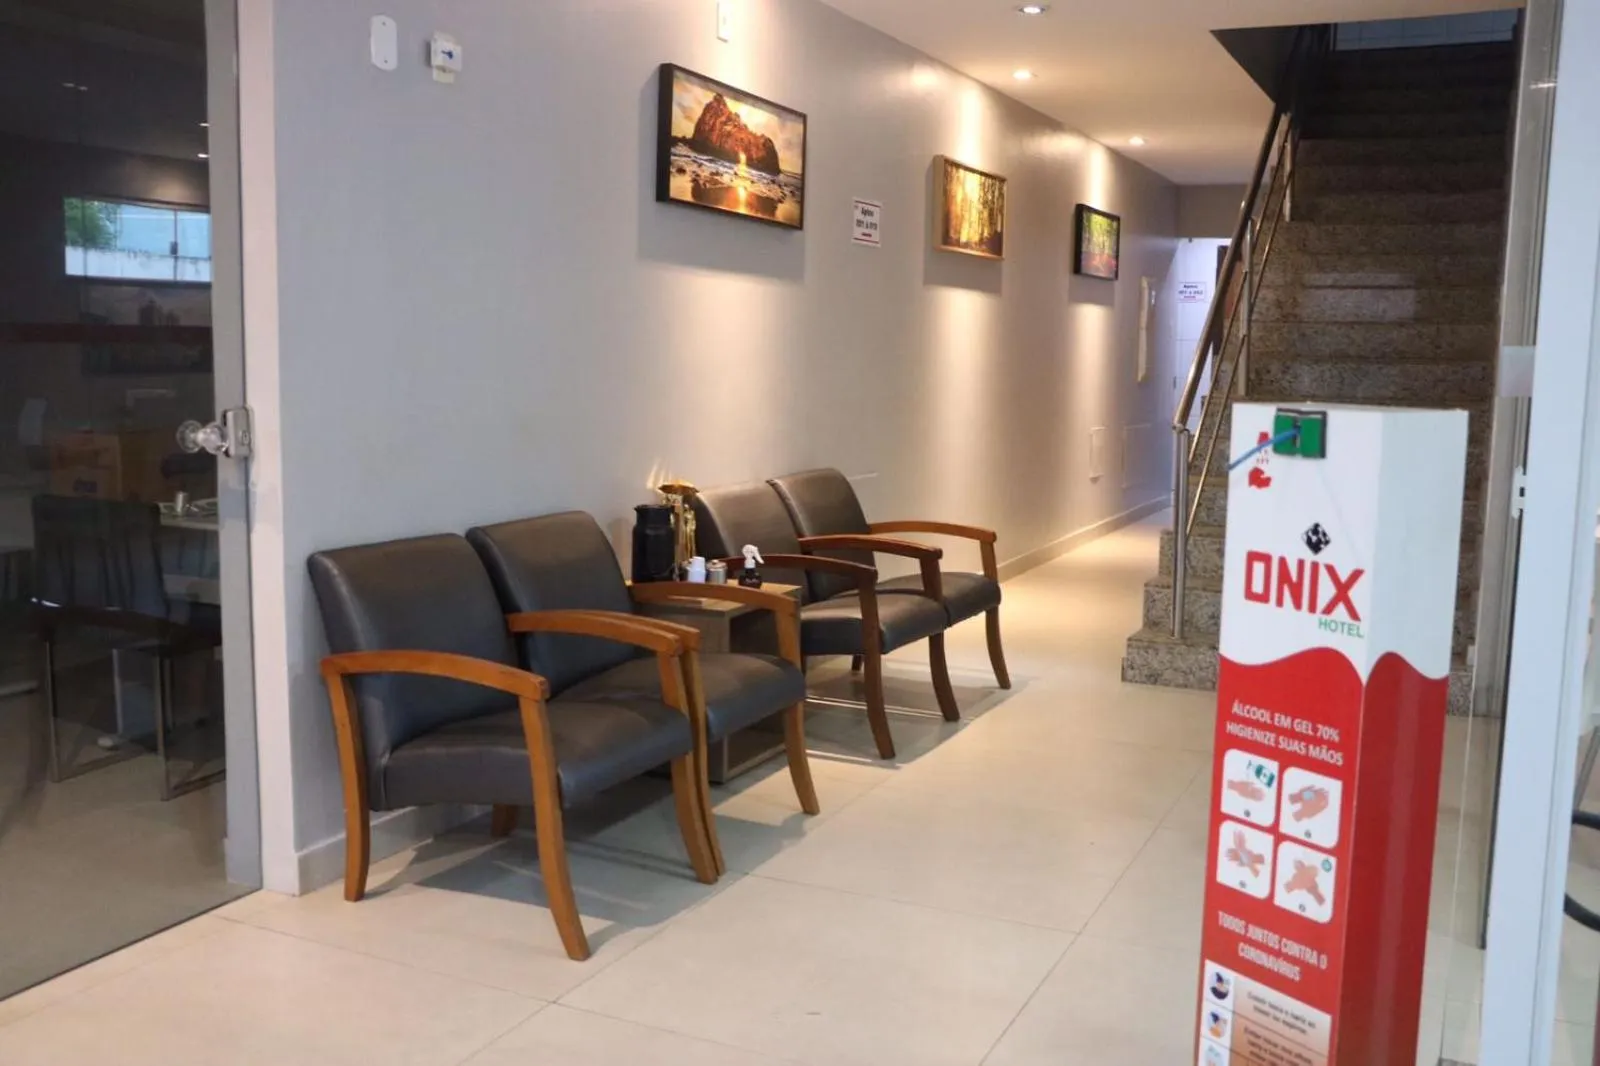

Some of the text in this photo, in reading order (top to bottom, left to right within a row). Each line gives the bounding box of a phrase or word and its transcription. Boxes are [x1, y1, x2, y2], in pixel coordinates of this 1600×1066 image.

[1244, 550, 1365, 622] ONIX
[1318, 618, 1364, 638] HOTEL
[1231, 699, 1340, 742] ÁLCOOL EM GEL 70%
[1225, 721, 1344, 767] HIGIENIZE SUAS MÃOS
[1218, 910, 1246, 936] TODOS
[1281, 937, 1318, 967] CONTRA
